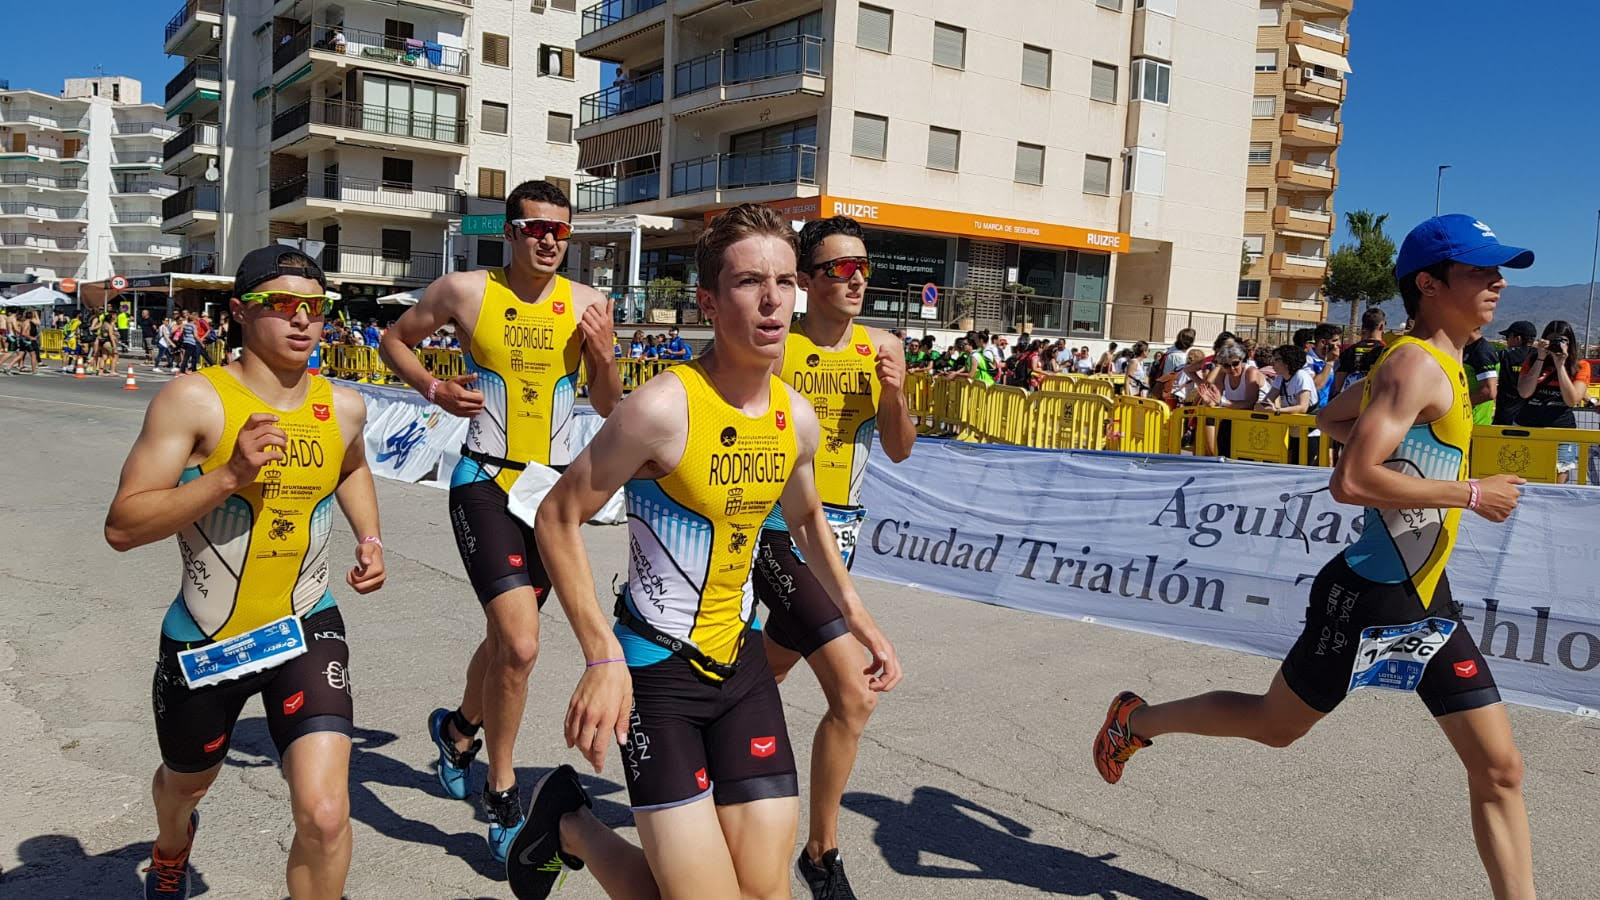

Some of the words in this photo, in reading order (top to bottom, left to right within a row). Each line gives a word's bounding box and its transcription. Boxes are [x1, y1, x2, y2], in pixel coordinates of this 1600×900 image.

[834, 201, 879, 219] RUIZRE
[974, 221, 982, 229] TU
[983, 223, 1004, 231] MARCA
[1014, 226, 1040, 236] SEGUROS
[1087, 232, 1121, 248] RUIZRE
[504, 325, 554, 350] RODRIGUEZ
[793, 371, 871, 395] DOMINGUEZ
[709, 453, 786, 486] RODRIGUEZ
[871, 518, 1004, 573] Ciudad
[1014, 537, 1226, 612] Triatlón
